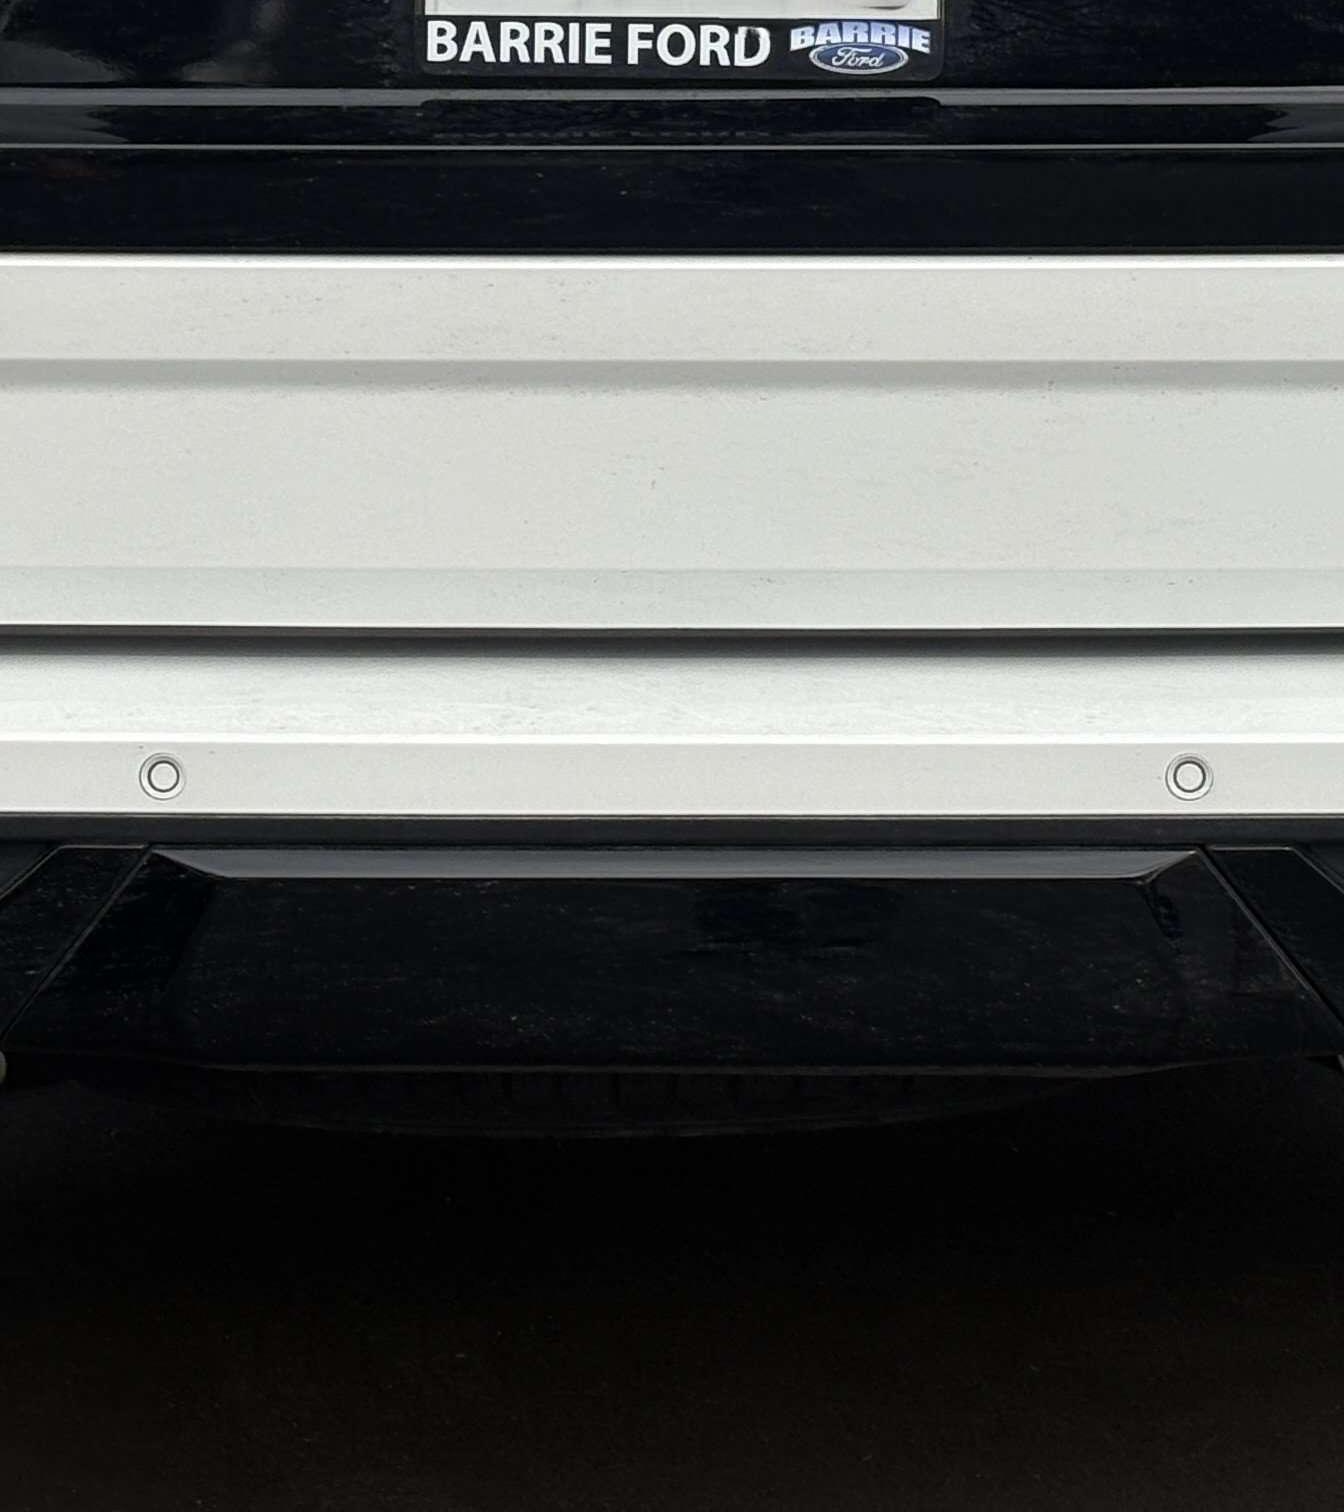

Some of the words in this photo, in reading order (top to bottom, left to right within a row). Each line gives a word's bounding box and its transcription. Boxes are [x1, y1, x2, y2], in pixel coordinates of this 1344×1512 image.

[426, 20, 613, 65] BARRIE
[627, 23, 771, 67] FORD
[790, 20, 931, 55] BARRIE
[831, 46, 885, 68] Ford
